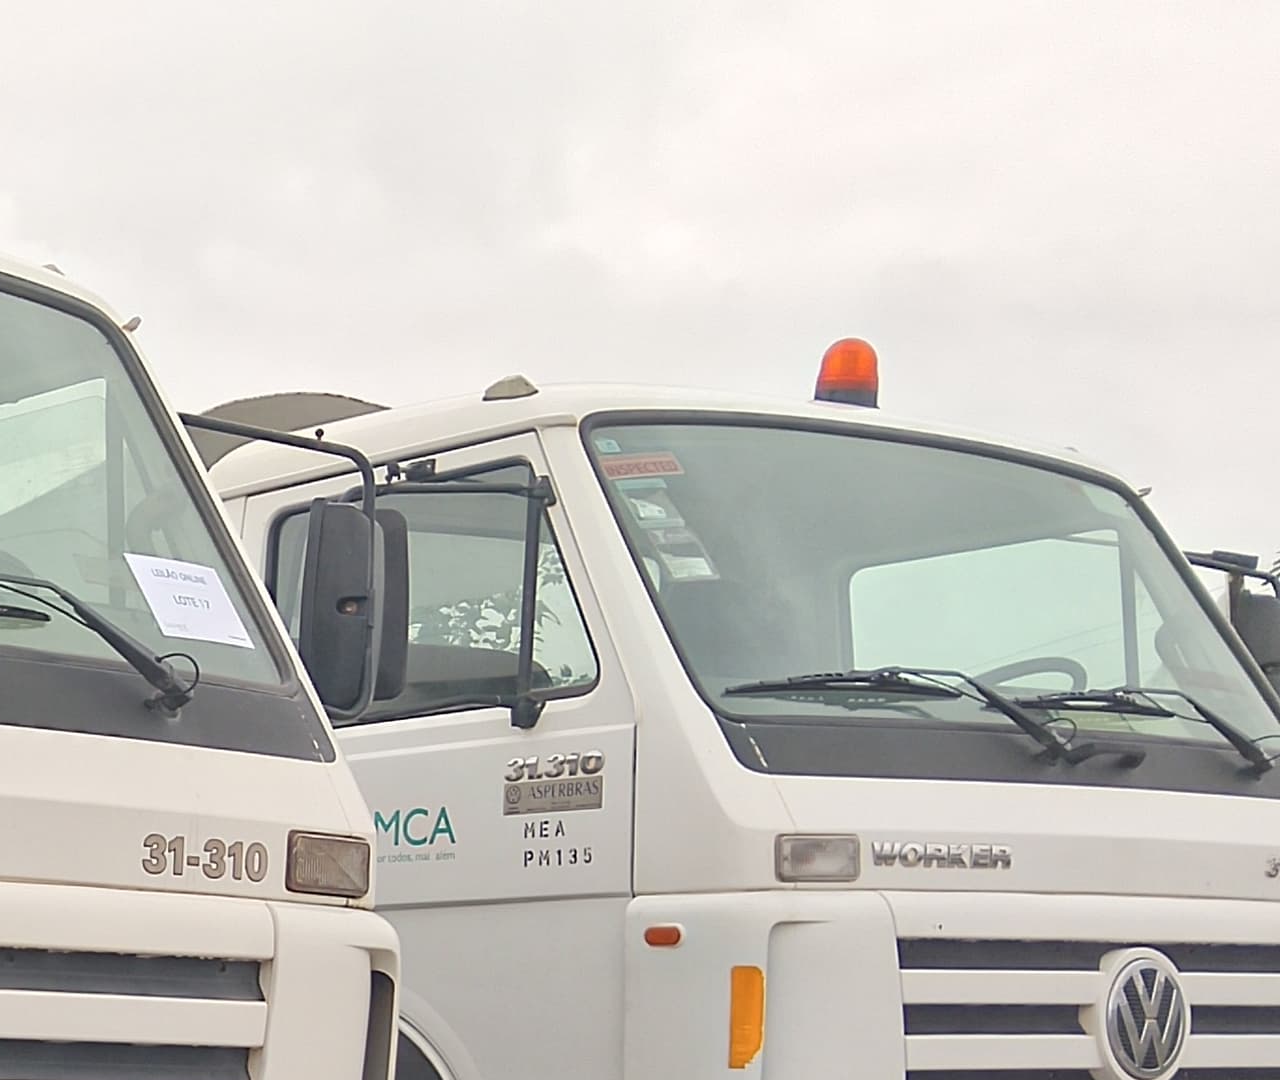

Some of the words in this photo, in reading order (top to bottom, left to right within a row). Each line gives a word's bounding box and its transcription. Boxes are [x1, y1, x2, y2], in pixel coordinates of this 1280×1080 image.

[172, 595, 199, 608] LOTE
[504, 749, 605, 782] 31.310
[374, 806, 456, 846] MCA
[524, 820, 565, 839] MEA
[141, 833, 269, 883] 31-310
[523, 847, 593, 868] PM135
[871, 841, 1012, 870] WORKER
